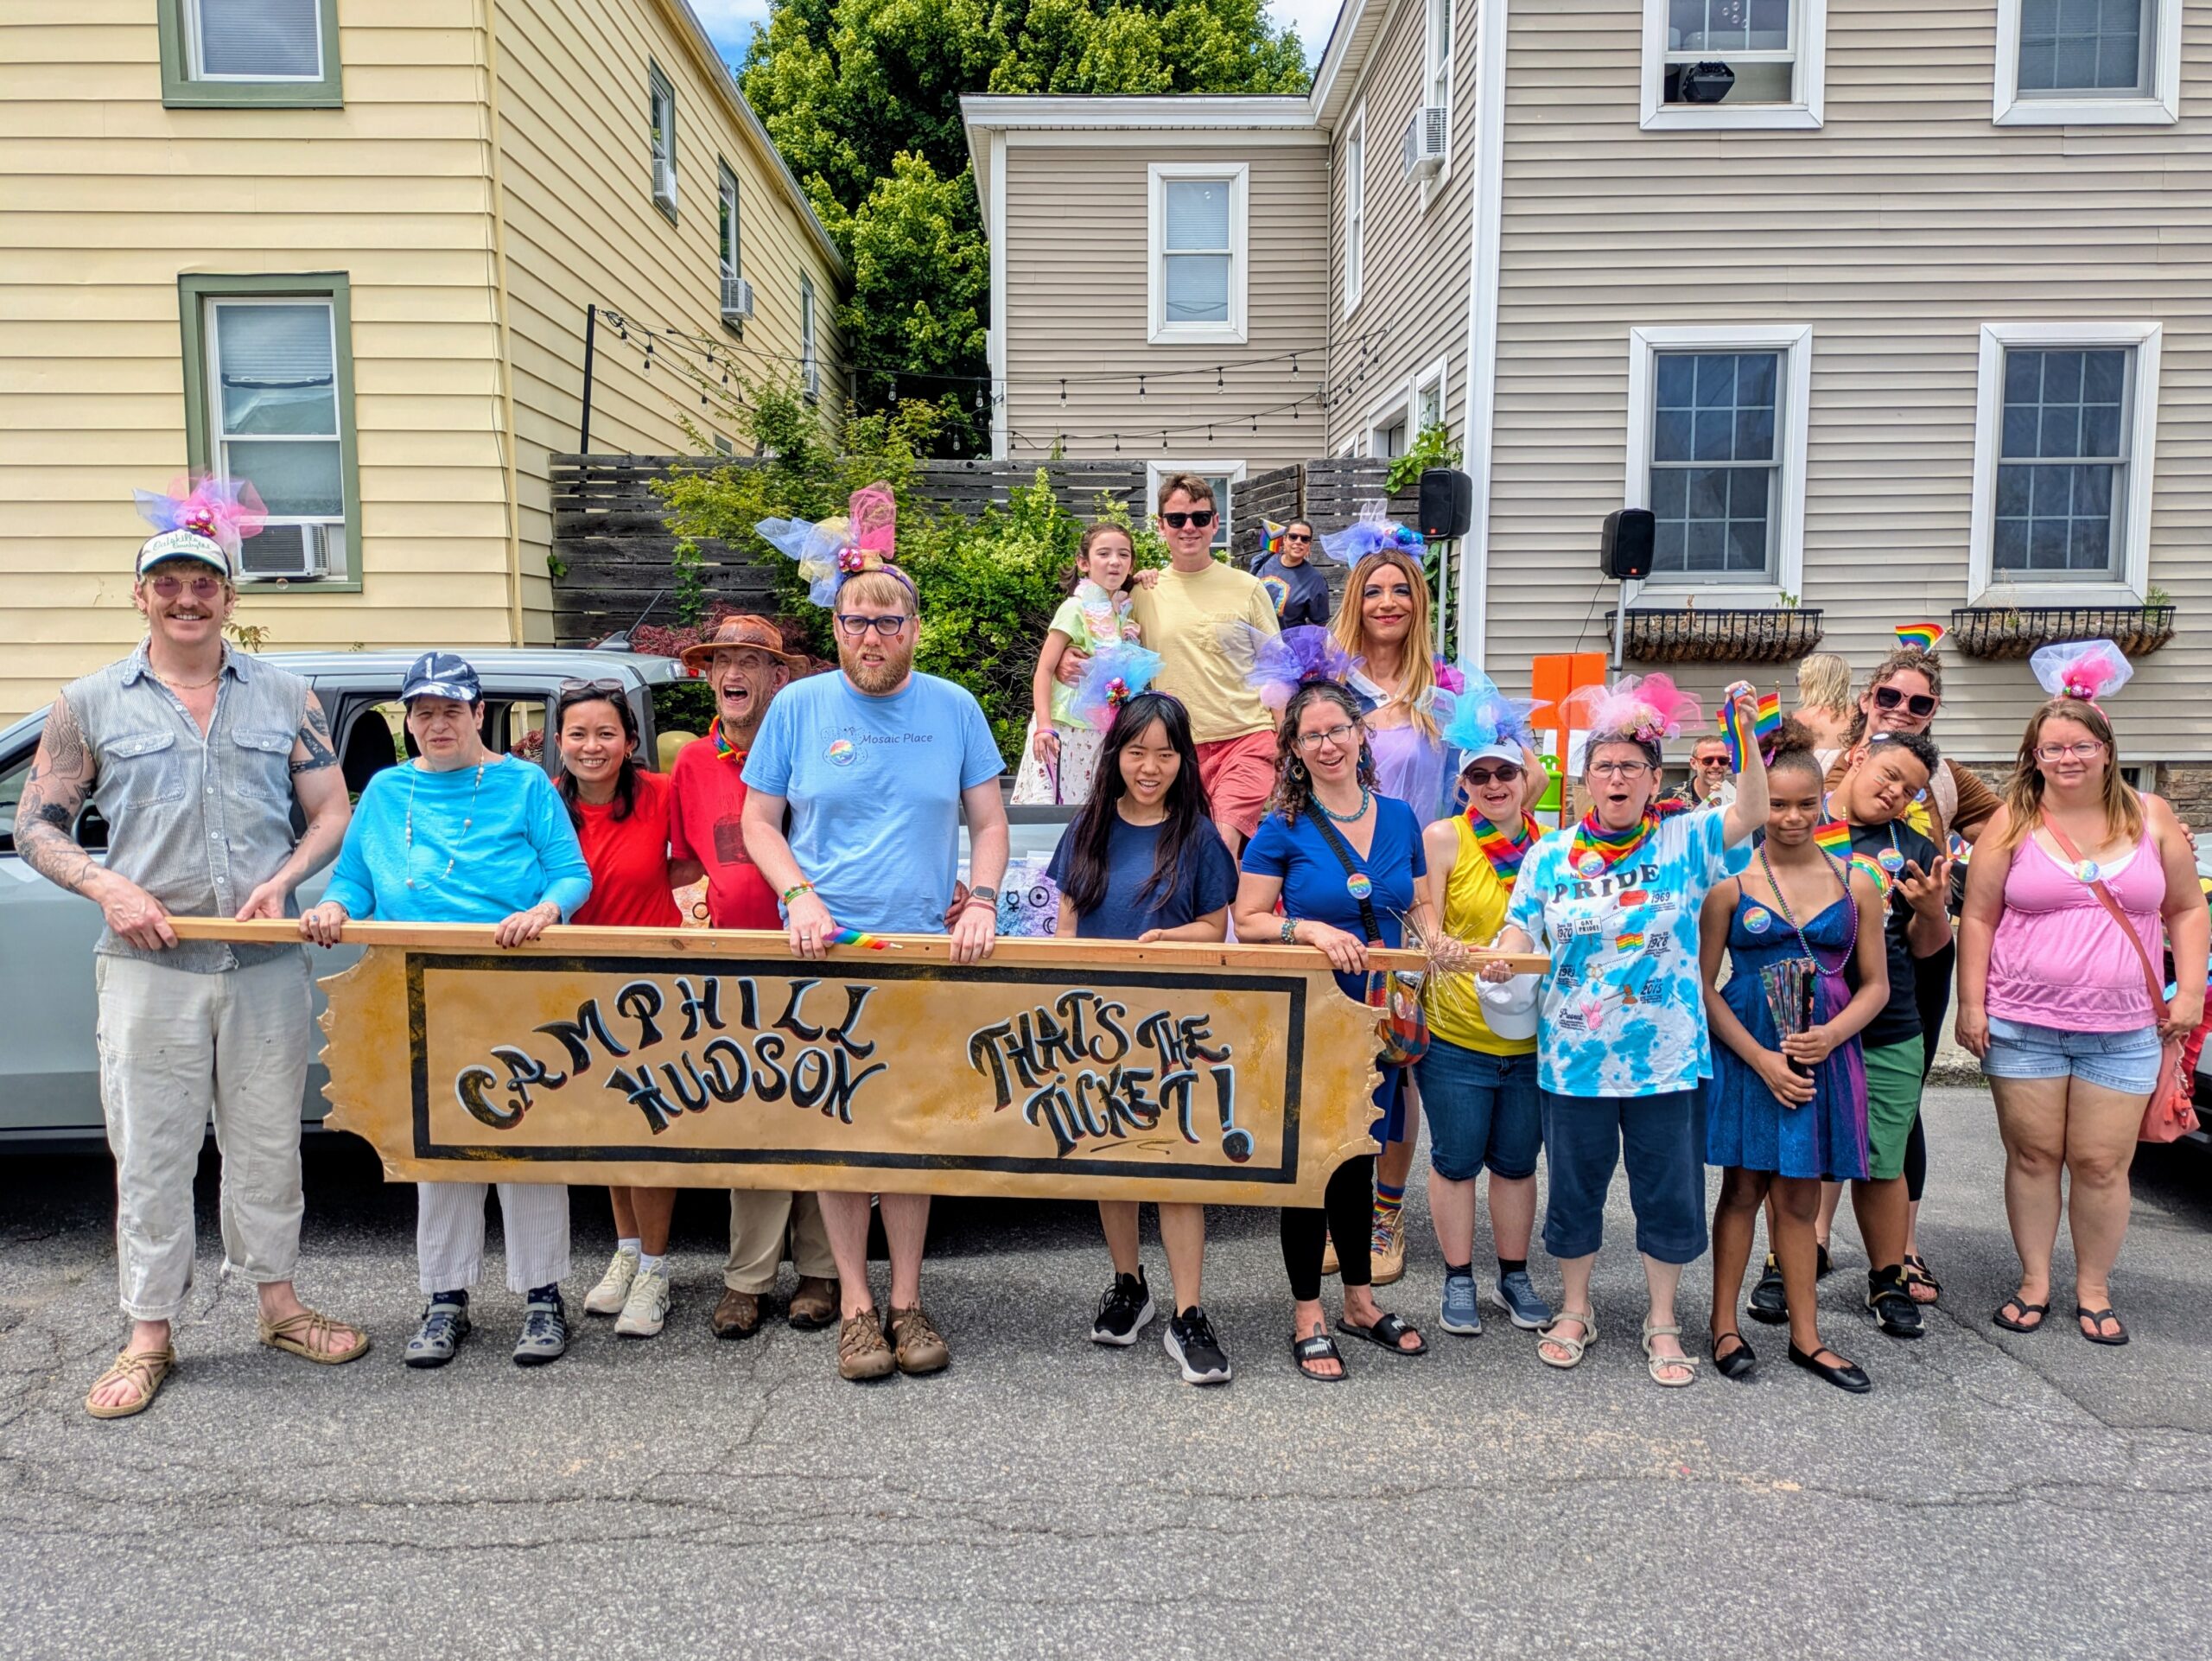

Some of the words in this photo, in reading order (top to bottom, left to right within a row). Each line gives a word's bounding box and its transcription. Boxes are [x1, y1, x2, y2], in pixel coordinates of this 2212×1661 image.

[862, 734, 900, 744] Mosaic
[903, 733, 933, 743] Place
[1552, 864, 1660, 904] PRIDE
[1651, 891, 1671, 904] 1969
[1557, 927, 1573, 939] 1970
[1648, 935, 1669, 949] 1978
[1640, 984, 1662, 996] 2015
[454, 977, 878, 1130] CAMPHILL
[967, 990, 1128, 1112] THAT'S
[1135, 1009, 1232, 1075] THE
[604, 1033, 888, 1135] HUDSON
